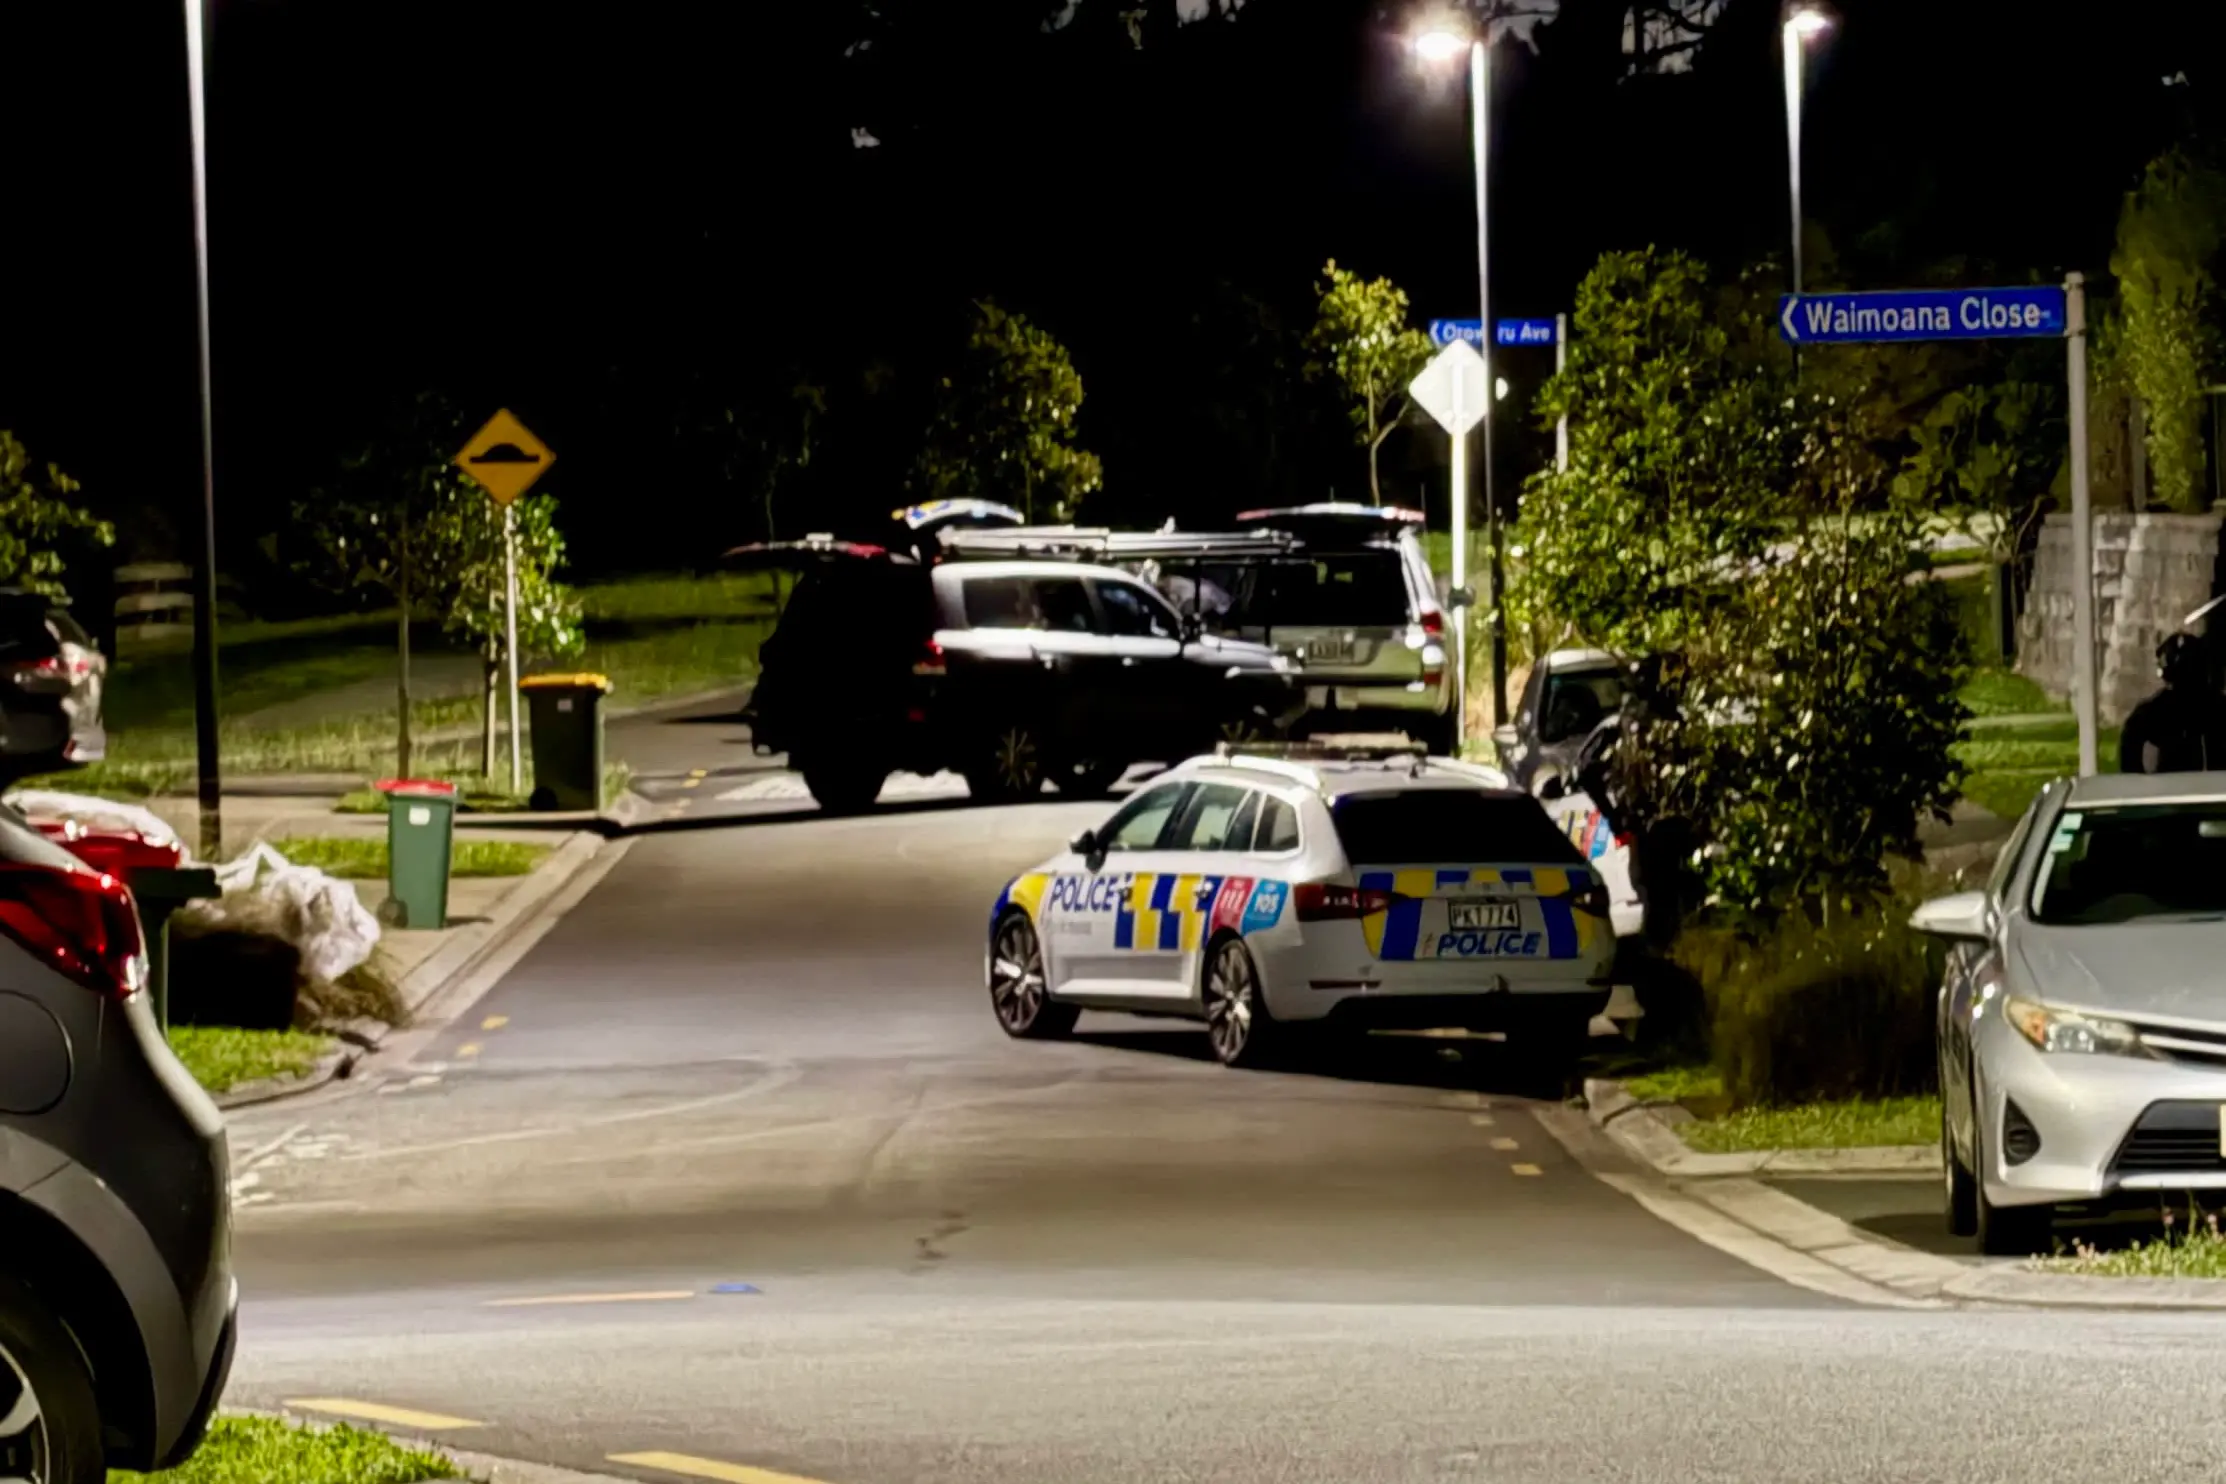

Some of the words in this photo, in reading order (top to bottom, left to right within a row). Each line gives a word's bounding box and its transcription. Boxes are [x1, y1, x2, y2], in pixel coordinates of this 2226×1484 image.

[1519, 321, 1550, 342] Ave
[1804, 301, 1951, 335] Waimoana
[1959, 297, 2041, 330] Close
[1048, 875, 1119, 912] POLICE
[1437, 932, 1541, 957] POLICE
